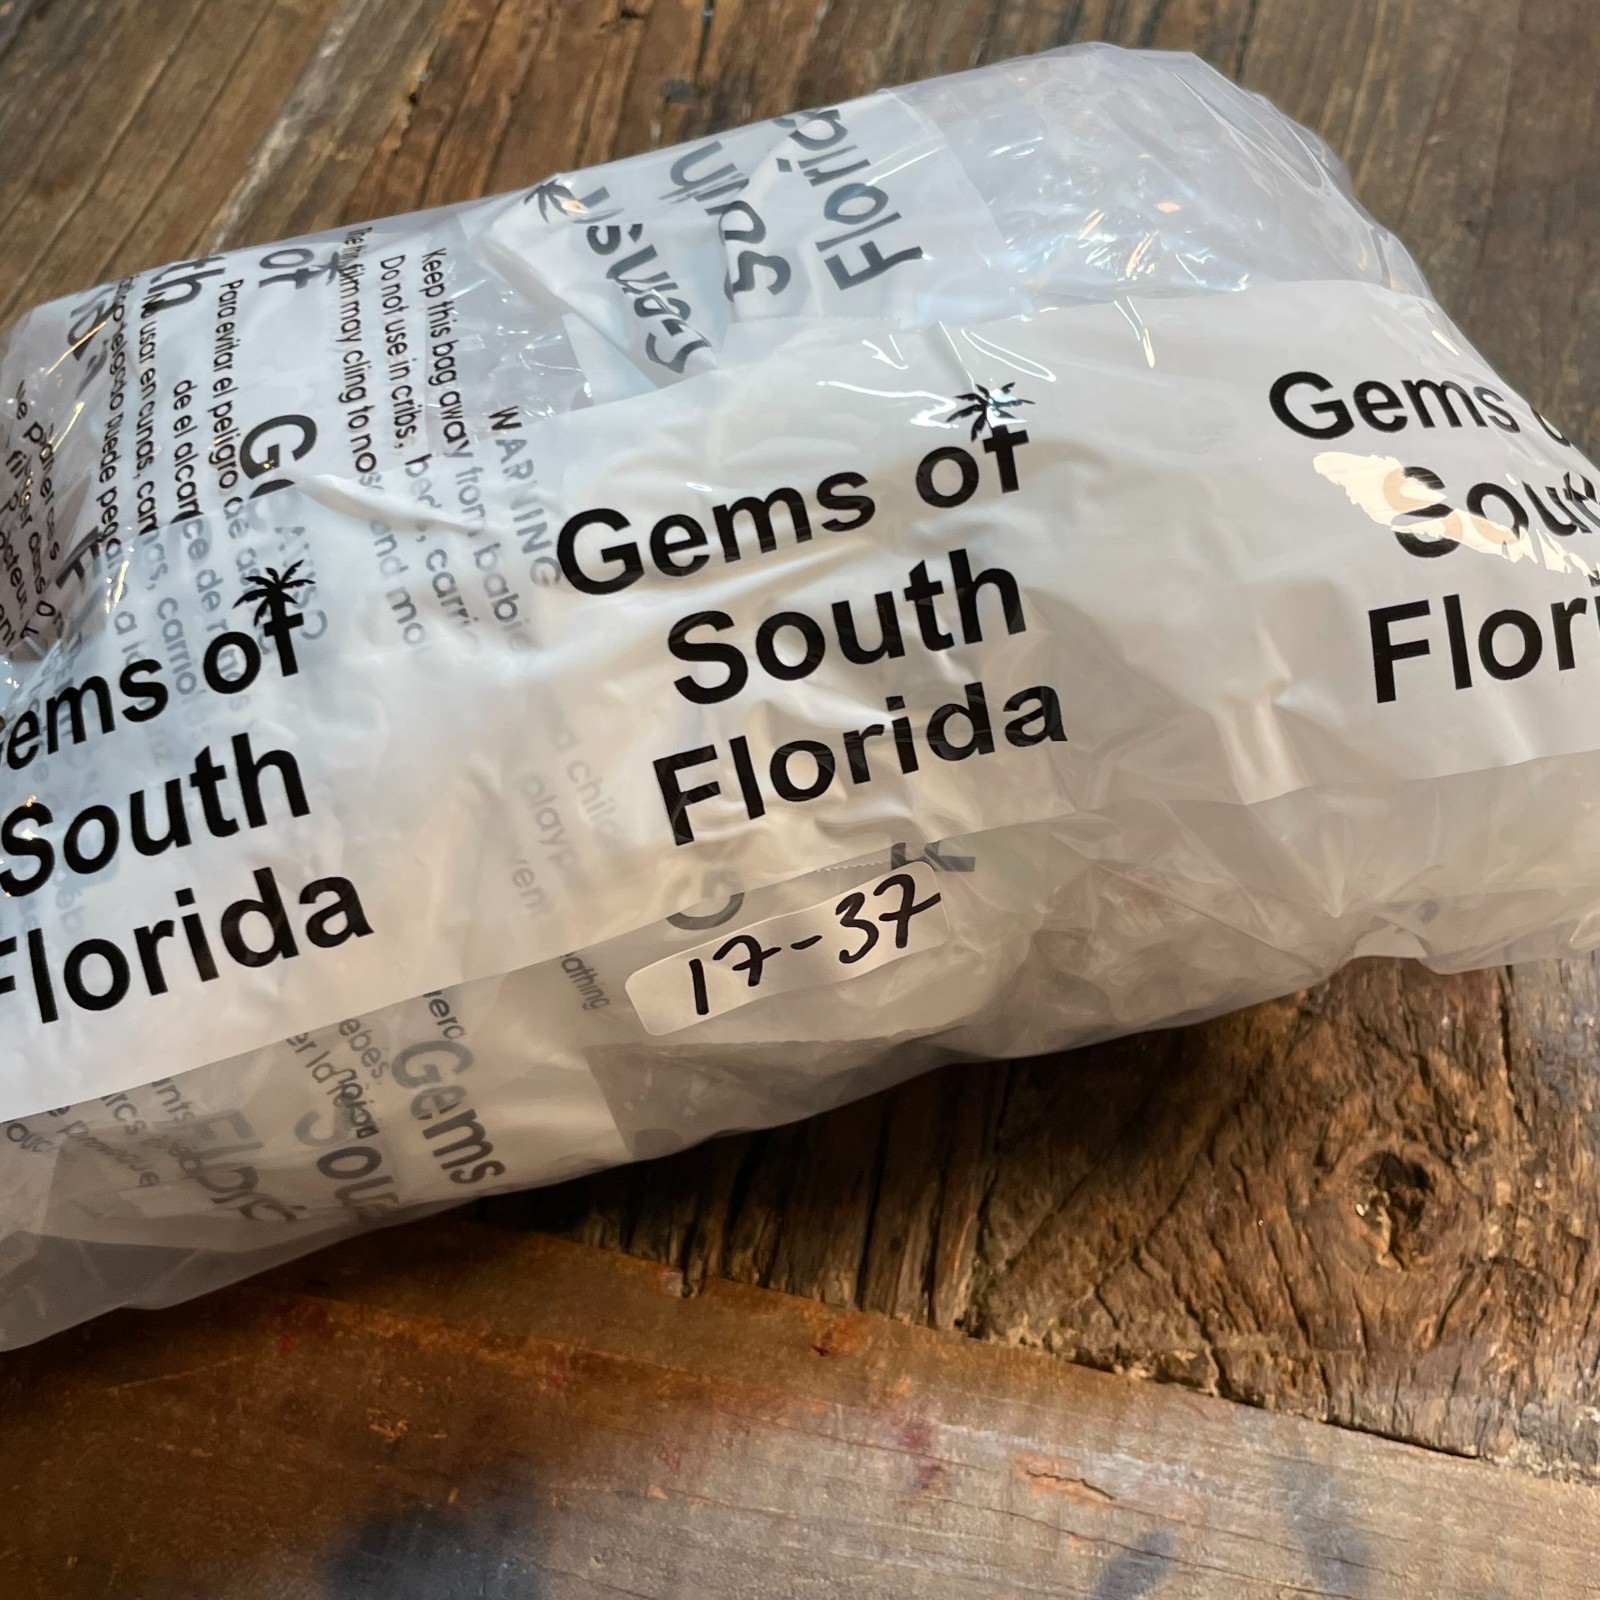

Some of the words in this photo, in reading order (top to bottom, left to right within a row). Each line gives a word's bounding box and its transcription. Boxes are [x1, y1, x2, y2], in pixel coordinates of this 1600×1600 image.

[380, 254, 406, 281] Do
[418, 248, 447, 298] Keep
[217, 279, 244, 319] Para
[336, 300, 363, 343] may
[381, 282, 410, 315] not
[427, 301, 458, 338] this
[139, 320, 157, 364] usar
[213, 322, 242, 372] evitar
[385, 318, 408, 357] use
[427, 339, 459, 386] bag
[139, 367, 157, 400] en
[212, 377, 239, 399] el
[338, 348, 371, 404] cling
[388, 358, 418, 380] in
[173, 379, 197, 410] de
[347, 405, 376, 430] to
[391, 383, 424, 450] cribs,
[1268, 370, 1521, 440] Gems
[99, 413, 125, 484] puede
[133, 400, 158, 479] cunas,
[174, 414, 200, 440] el
[208, 399, 243, 490] peligro
[439, 391, 473, 459] away
[556, 471, 876, 596] Gems
[916, 404, 1030, 509] of
[195, 567, 224, 613] de
[667, 548, 1028, 705] South
[4, 657, 169, 771] ems
[204, 592, 306, 695] of
[652, 681, 1068, 847] Florida
[0, 732, 312, 898] South
[688, 873, 942, 1016] 17-37
[391, 1039, 507, 1185] Gems
